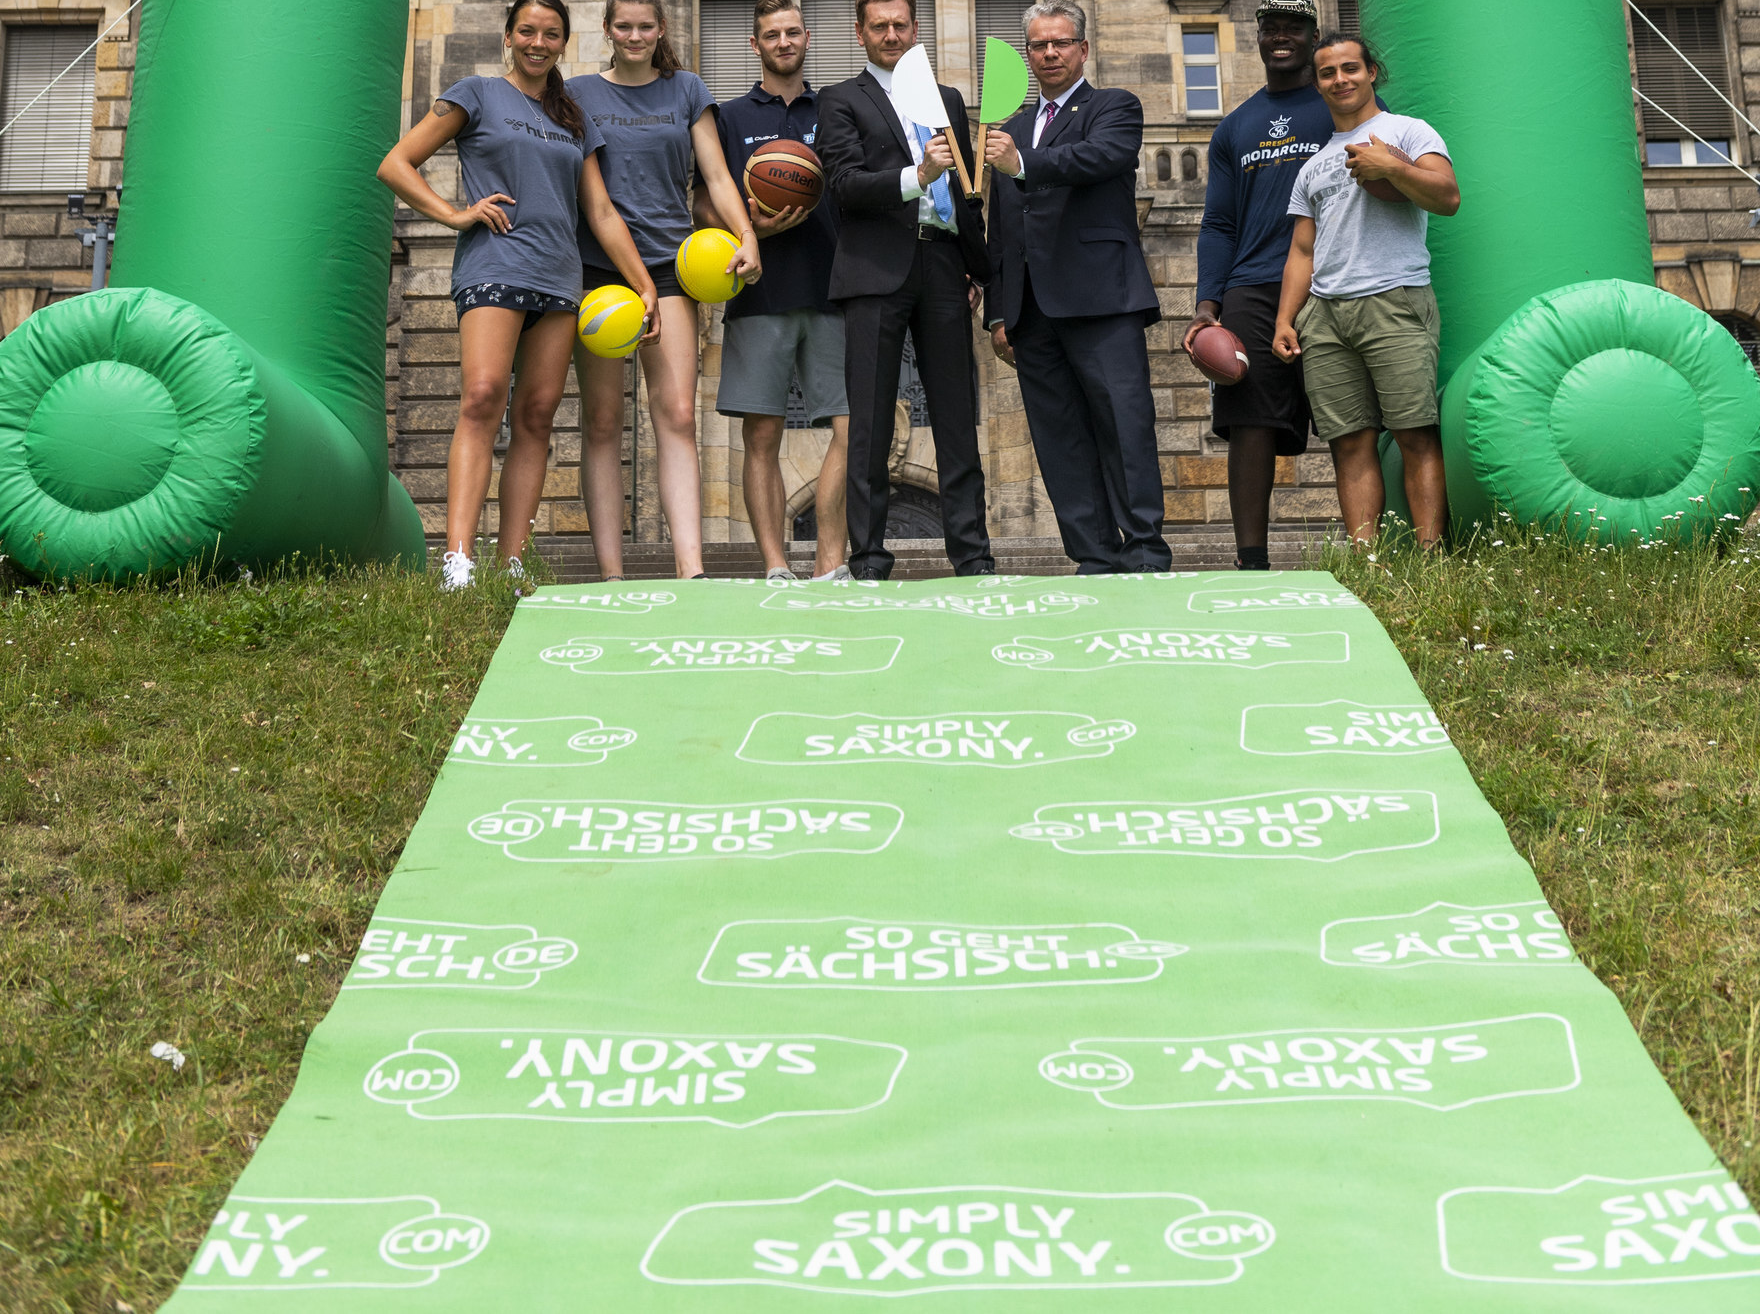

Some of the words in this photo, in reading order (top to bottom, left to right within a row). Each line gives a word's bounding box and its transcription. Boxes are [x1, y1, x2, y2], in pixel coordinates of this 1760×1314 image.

[610, 112, 676, 127] hummel
[525, 122, 582, 151] hummel
[1241, 143, 1320, 168] MONARCHS
[768, 167, 815, 189] molten
[545, 648, 598, 660] COM
[630, 639, 842, 656] SAXONY.
[997, 648, 1047, 662] COM
[1074, 632, 1293, 654] SAXONY.
[1107, 645, 1252, 663] SIMPLY
[650, 651, 797, 667] SIMPLY
[460, 724, 519, 741] LY
[573, 733, 632, 747] COM
[856, 720, 1010, 740] SIMPLY
[1072, 724, 1130, 742] COM
[453, 735, 538, 761] NY.
[804, 734, 1044, 760] SAXONY.
[541, 806, 871, 836] SÄCHSISCH.
[1072, 795, 1411, 833] SÄCHSISCH.
[478, 817, 532, 837] DE
[1019, 825, 1075, 836] DE
[1117, 823, 1246, 847] GEHT
[1258, 825, 1323, 848] SO
[568, 833, 685, 854] GEHT
[711, 832, 774, 853] SO
[1447, 912, 1521, 933] SO
[360, 929, 468, 954] EHT
[845, 926, 914, 950] SO
[929, 929, 1069, 951] GEHT
[1116, 946, 1177, 955] DE
[1351, 932, 1571, 963] SÄCHS
[352, 953, 496, 980] SCH.
[503, 943, 565, 966] DE
[736, 945, 1117, 980] SÄCHSISCH.
[500, 1038, 817, 1079] SAXONY.
[1163, 1033, 1489, 1073] SAXONY.
[371, 1068, 454, 1092] COM
[1047, 1061, 1128, 1082] COM
[1215, 1064, 1433, 1093] SIMPLY
[527, 1070, 746, 1109] SIMPLY
[832, 1201, 1075, 1239] SIMPLY
[388, 1229, 482, 1254] COM
[1173, 1222, 1265, 1248] COM
[1540, 1213, 1760, 1272] SAXO
[194, 1239, 329, 1278] NY.
[753, 1236, 1131, 1281] SAXONY.
